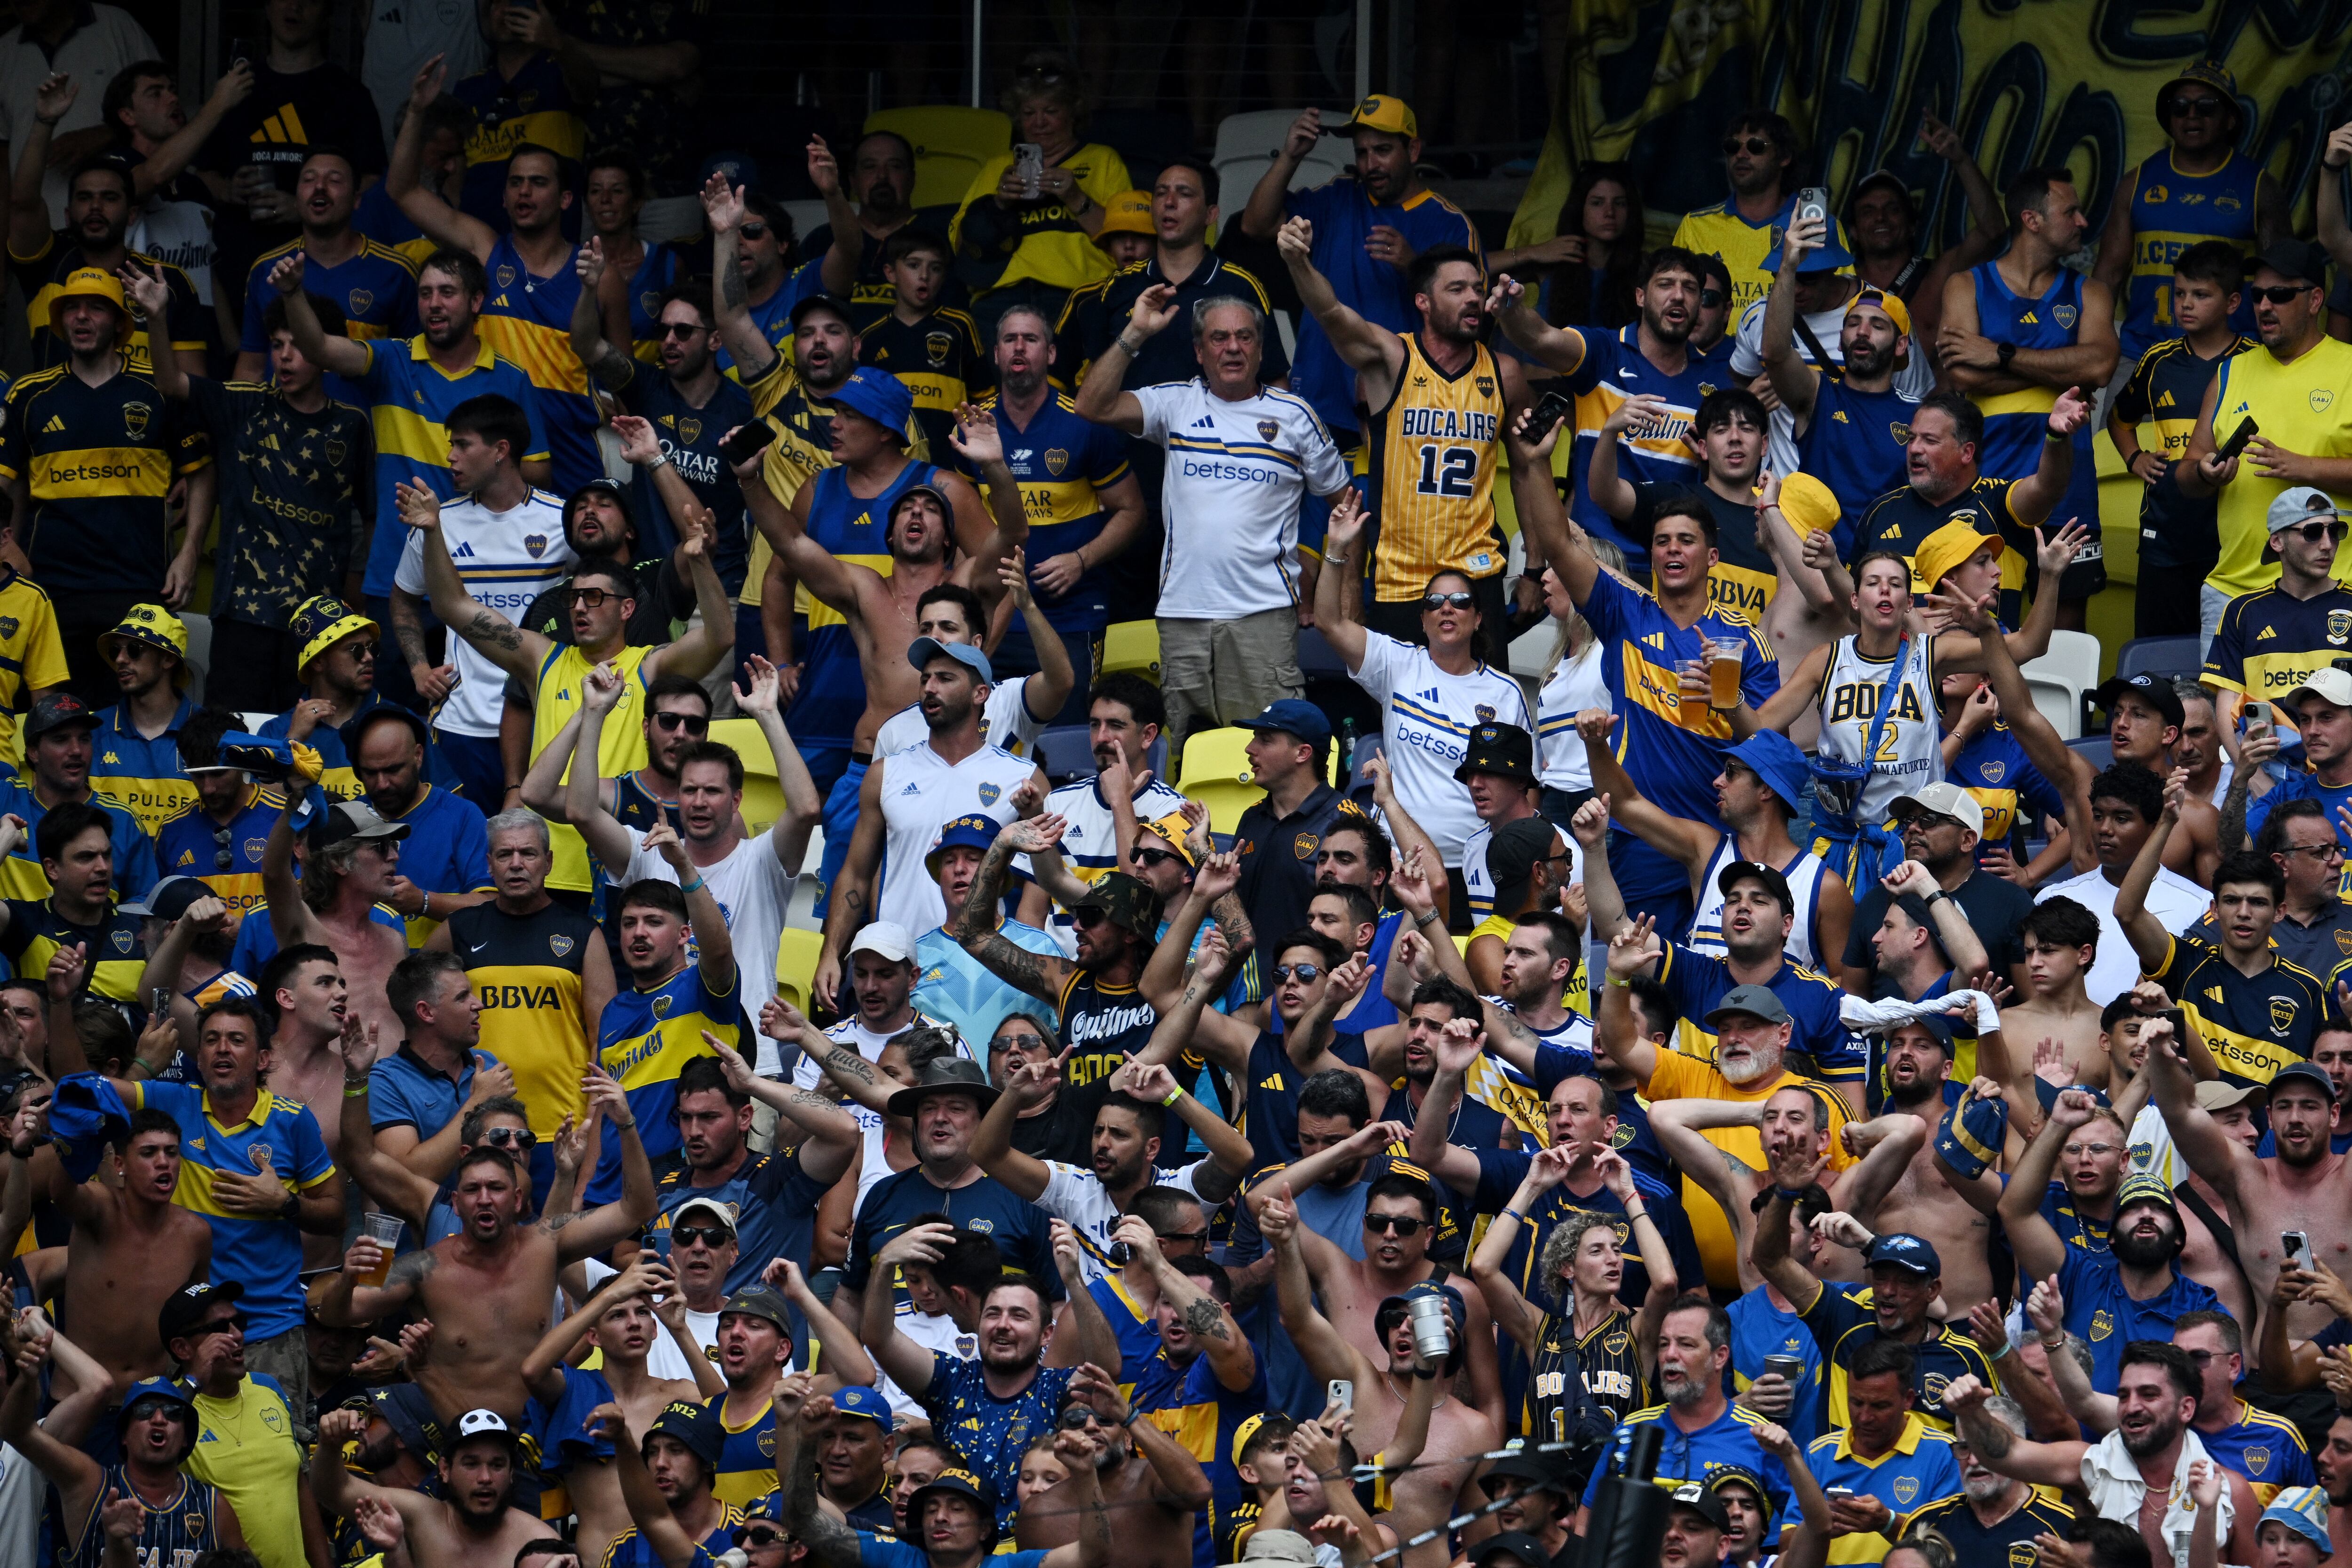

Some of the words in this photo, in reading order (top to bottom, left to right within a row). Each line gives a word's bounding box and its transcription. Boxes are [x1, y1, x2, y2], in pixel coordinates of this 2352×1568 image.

[253, 151, 271, 162] BOCA
[273, 152, 302, 163] JUNIORS
[1019, 206, 1077, 225] GATOR
[147, 242, 210, 269] Quilme
[1402, 409, 1497, 442] BOCAJRS
[660, 439, 718, 472] QATAR
[780, 441, 823, 474] bets
[49, 464, 141, 484] betsson
[1183, 459, 1279, 486] betsson
[1416, 445, 1477, 497] 12
[252, 485, 335, 527] betsson
[1019, 490, 1052, 507] TAR
[1025, 509, 1053, 519] WAYS
[323, 603, 339, 612] CABJ
[471, 591, 535, 608] etsso
[2265, 668, 2315, 688] bets
[1398, 723, 1468, 762] betsso
[1870, 758, 1930, 775] LMAFUERTE
[129, 792, 190, 809] PULSE
[1297, 840, 1314, 849] CABJ
[218, 894, 267, 910] sson
[482, 986, 561, 1011] BBVA
[1070, 1003, 1155, 1048] Quilmes
[1845, 1042, 1866, 1051] AXIO
[2210, 1037, 2281, 1072] etsson
[1069, 1054, 1123, 1087] BOC
[1499, 1087, 1549, 1116] QATA
[1514, 1109, 1548, 1130] AIRWA
[1615, 1131, 1631, 1140] CABJ
[2132, 1149, 2150, 1158] CABJ
[1438, 1226, 1458, 1241] CETROG
[2093, 1319, 2112, 1330] CABJ
